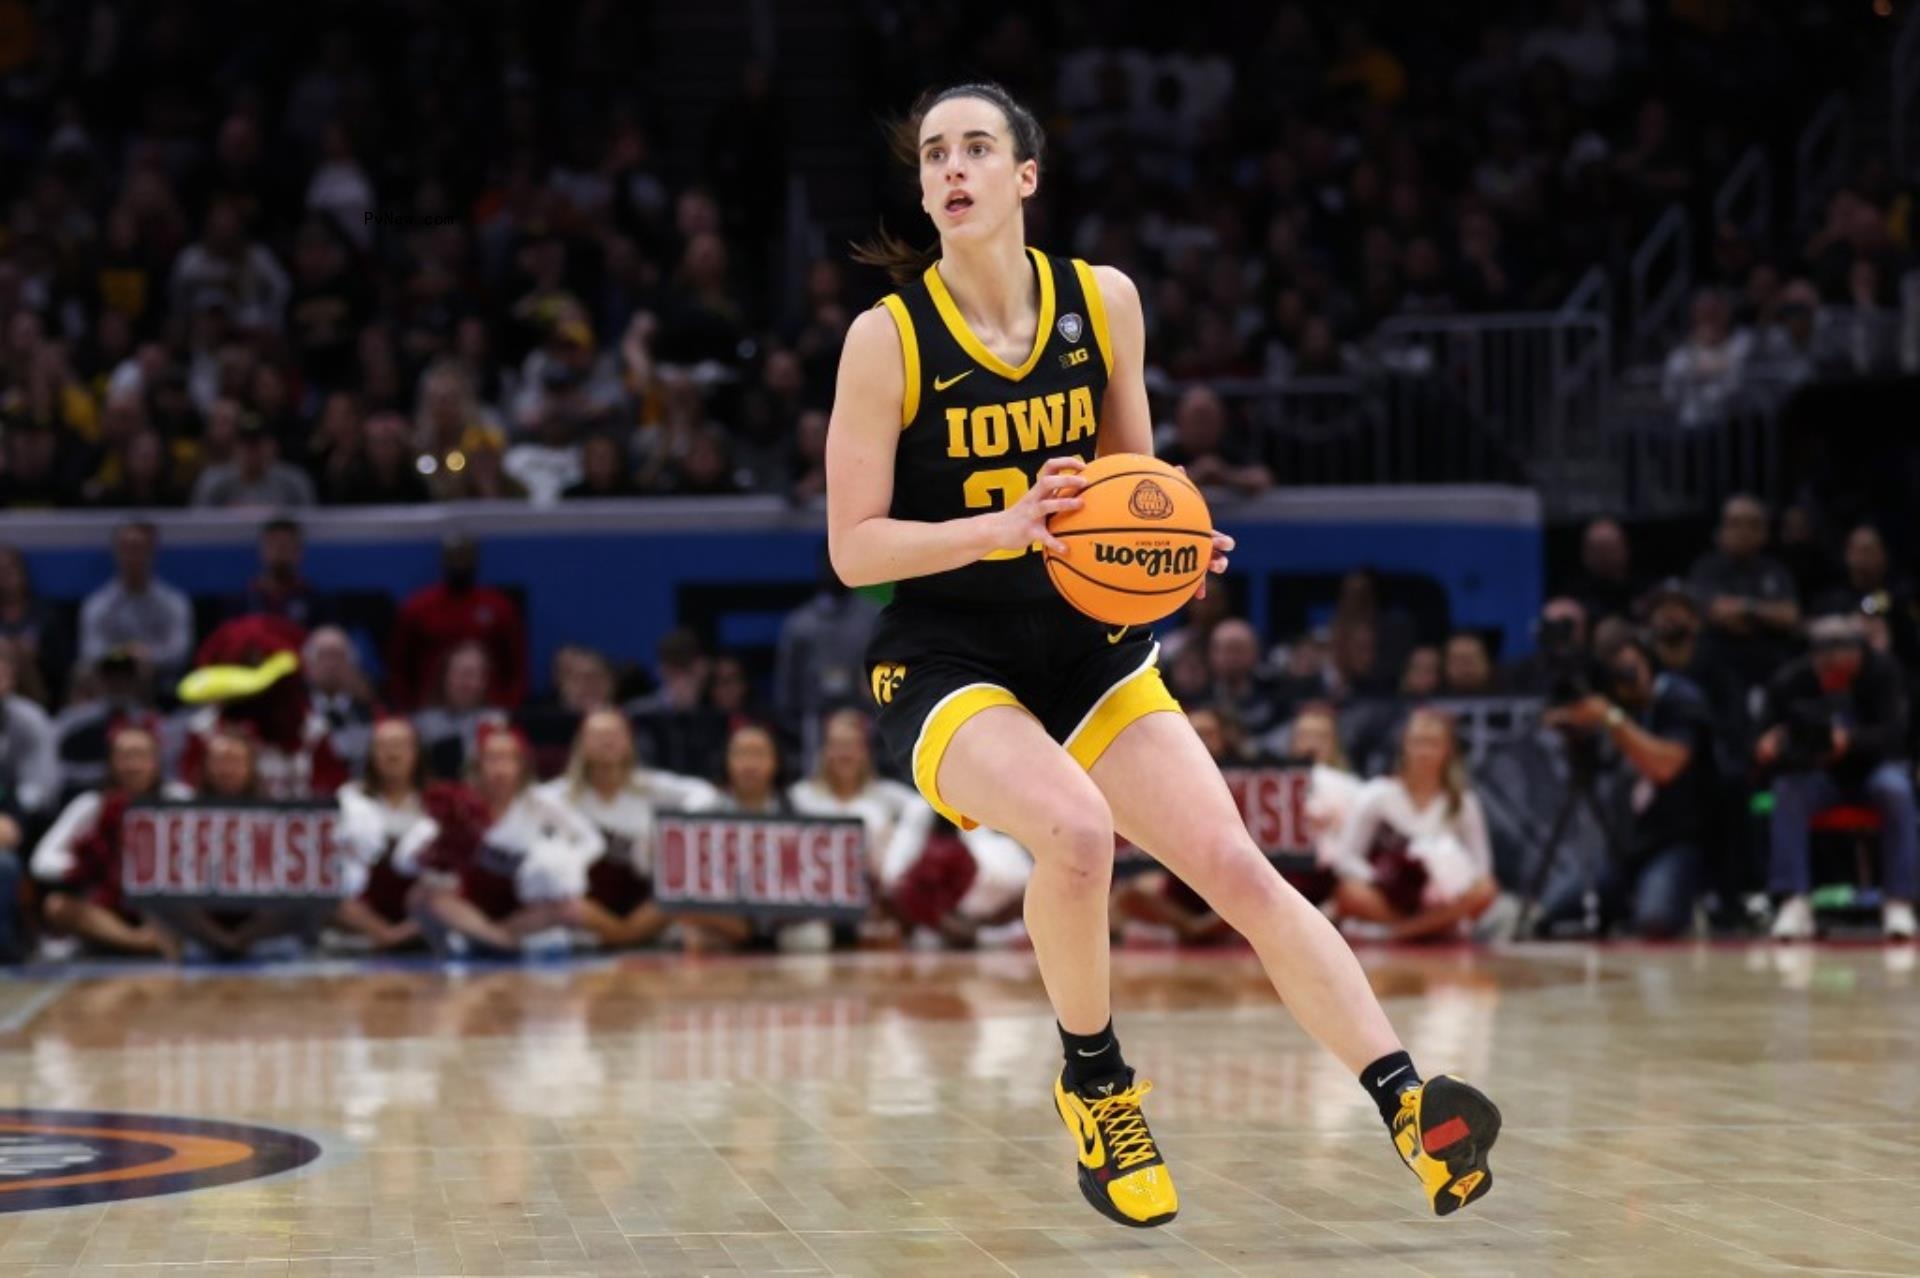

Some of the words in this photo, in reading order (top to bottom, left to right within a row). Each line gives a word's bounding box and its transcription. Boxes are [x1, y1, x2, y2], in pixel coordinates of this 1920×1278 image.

[945, 385, 1096, 458] IOWA
[1095, 543, 1198, 577] Wilson
[126, 815, 337, 888] DEFENSE
[663, 823, 863, 901] DEFENSE
